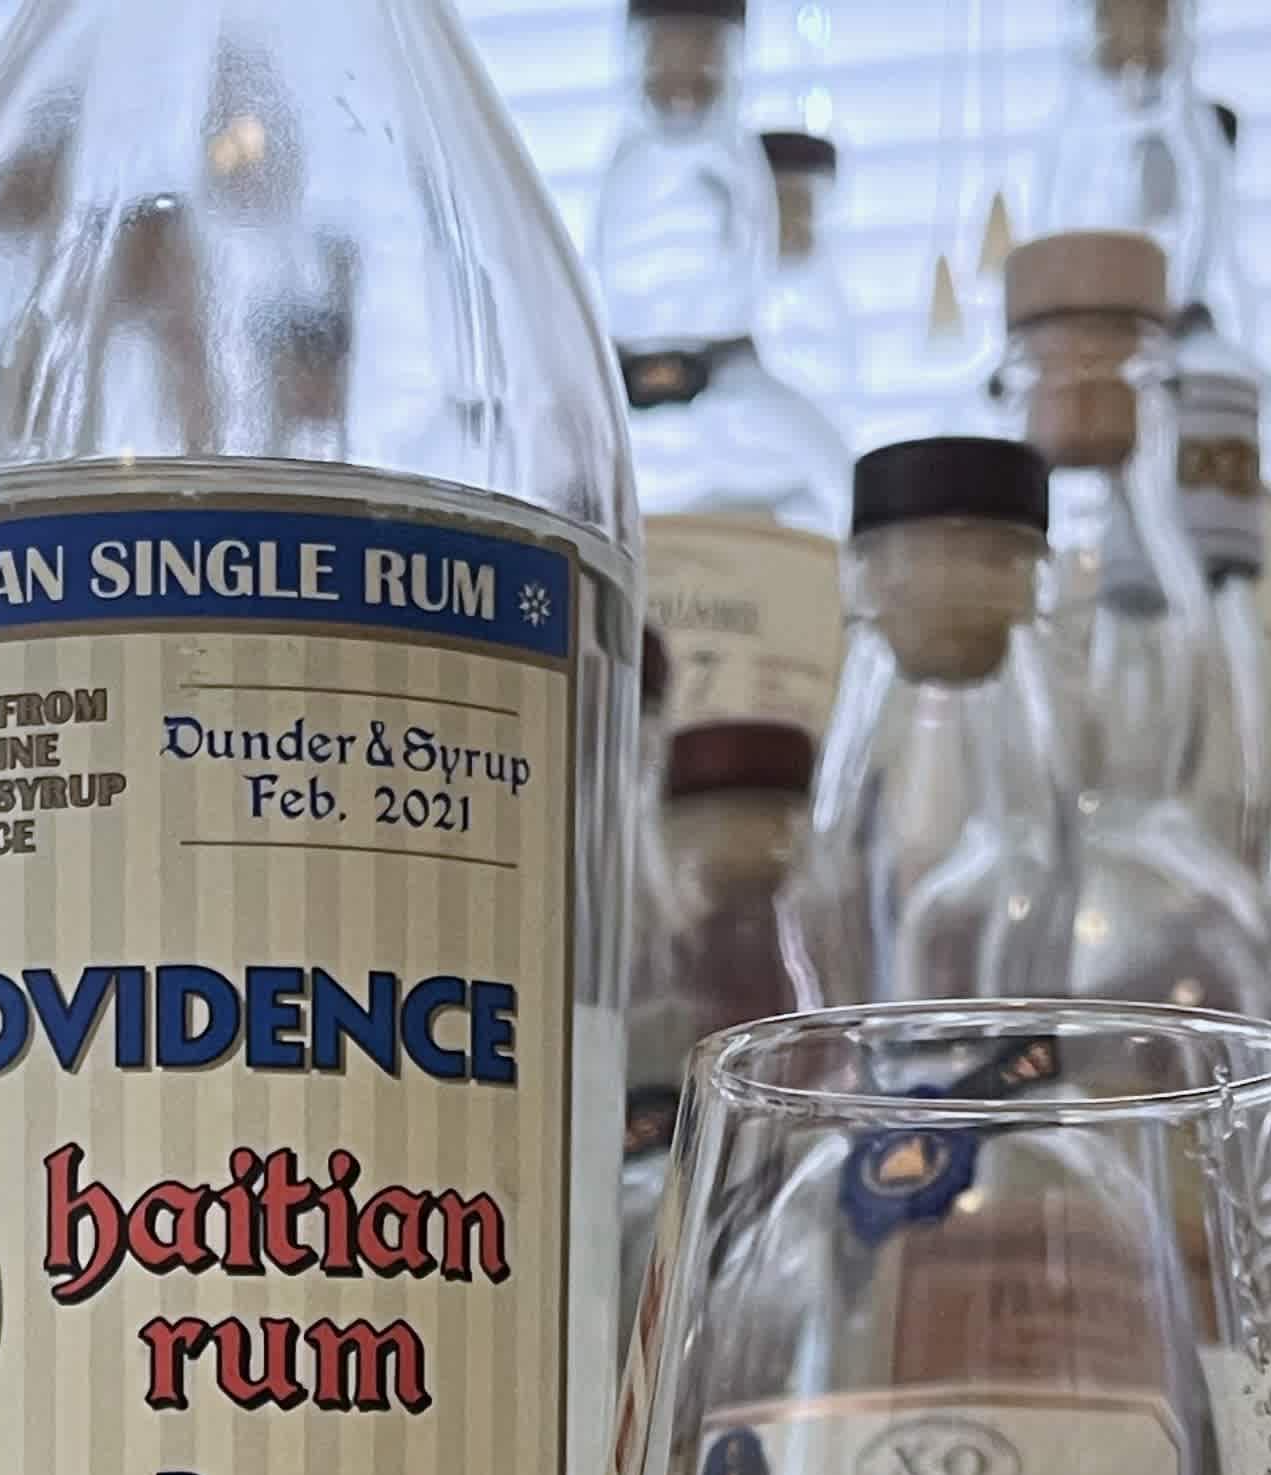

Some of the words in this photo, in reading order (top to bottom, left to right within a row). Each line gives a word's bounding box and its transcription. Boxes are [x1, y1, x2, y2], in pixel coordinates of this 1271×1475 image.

[90, 540, 339, 601] SINGLE
[364, 548, 497, 623] RUM
[243, 773, 347, 822] Feb.
[373, 785, 472, 833] 2021
[42, 1141, 511, 1306] haitian
[138, 1315, 432, 1414] rum
